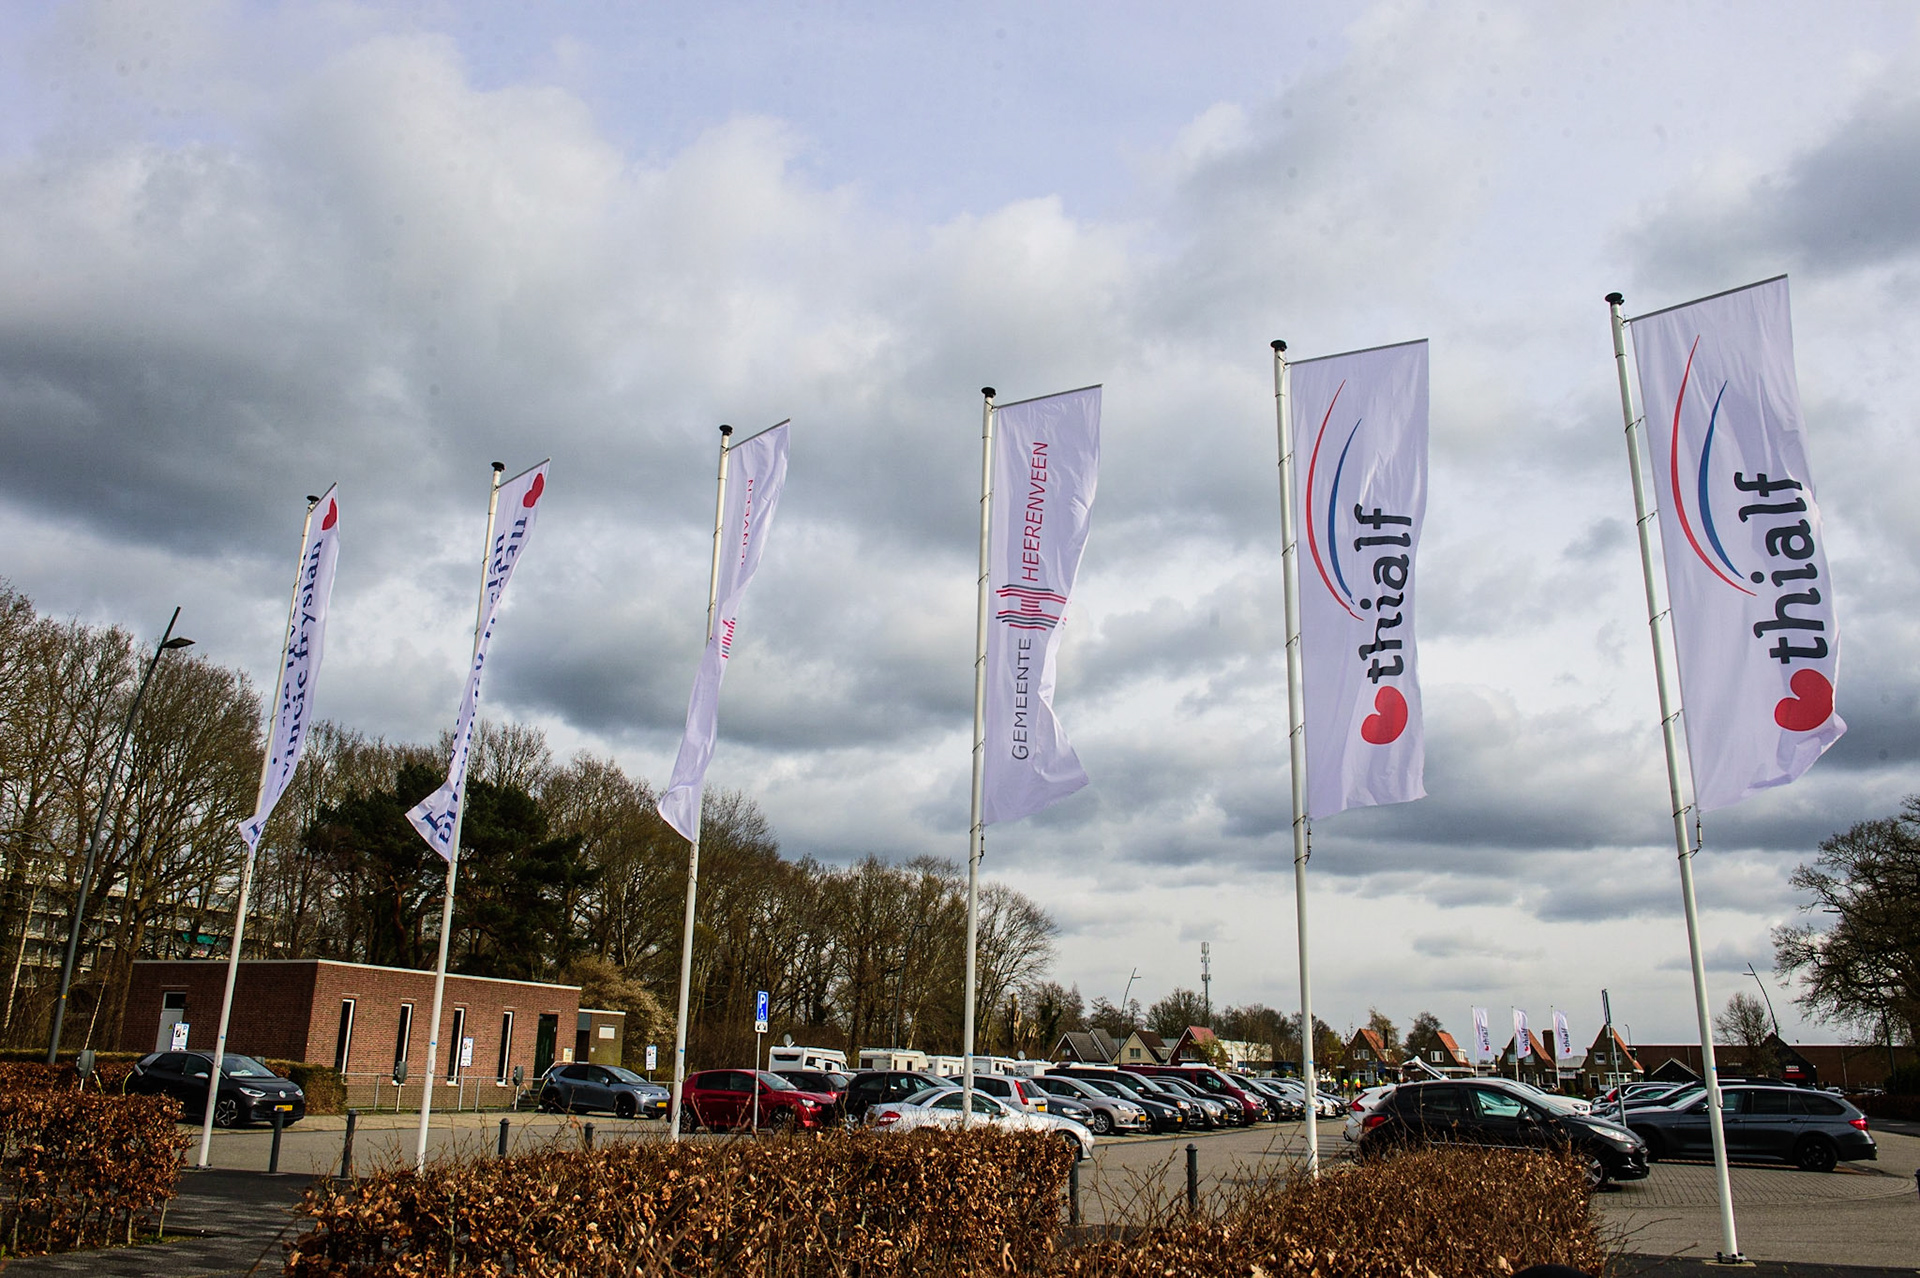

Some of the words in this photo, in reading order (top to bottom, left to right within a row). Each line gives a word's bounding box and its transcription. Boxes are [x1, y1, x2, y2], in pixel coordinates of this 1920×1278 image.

[1011, 638, 1032, 761] GEMEENTE
[1022, 442, 1048, 582] HEERENVEEN
[1354, 503, 1412, 684] thialf
[1733, 471, 1829, 665] thialf
[760, 994, 766, 1009] P
